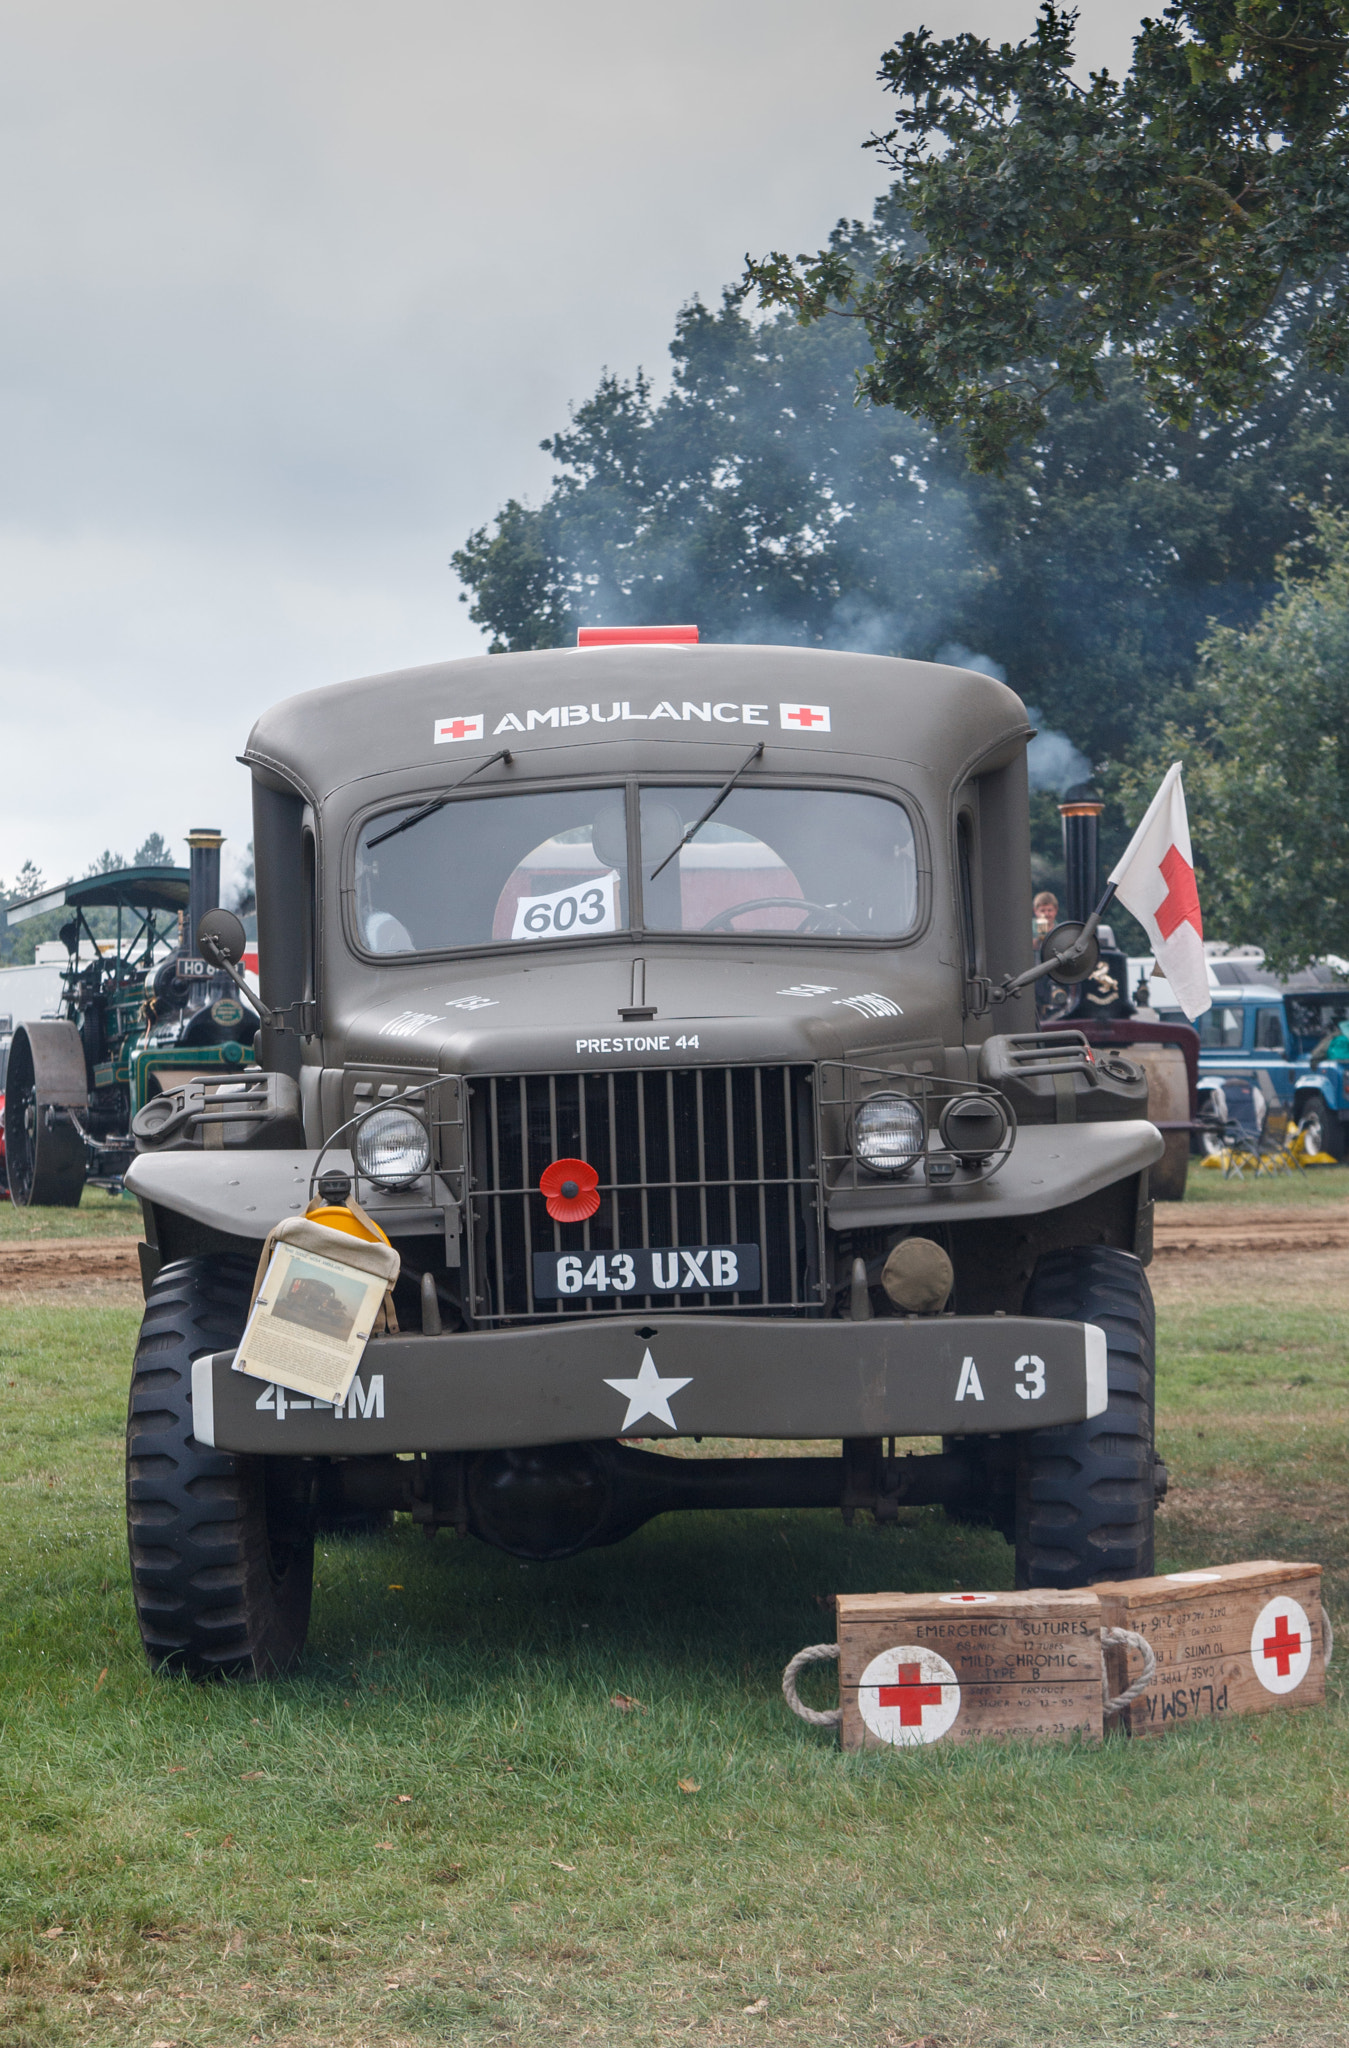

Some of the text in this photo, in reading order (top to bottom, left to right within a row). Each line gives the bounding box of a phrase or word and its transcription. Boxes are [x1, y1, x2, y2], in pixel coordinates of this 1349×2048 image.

[493, 701, 769, 735] AMBULANCE
[523, 888, 606, 933] 603
[184, 962, 204, 975] HO
[776, 983, 838, 997] USA
[445, 995, 499, 1011] USA
[576, 1035, 700, 1054] PRESTONE 44
[556, 1250, 739, 1293] 643 UXB
[953, 1354, 1047, 1403] A 3
[1210, 1607, 1226, 1617] DATE
[916, 1621, 1088, 1639] EMERGENCY SUTURES
[1023, 1641, 1034, 1651] 12
[1185, 1644, 1211, 1659] UNITS
[1213, 1643, 1224, 1654] 10
[960, 1654, 1078, 1668] MILD CHROMIC
[985, 1667, 1041, 1680] TYPE B
[1021, 1686, 1065, 1695] PRODUCT
[1146, 1685, 1228, 1721] PLASMA
[960, 1728, 982, 1736] DATE
